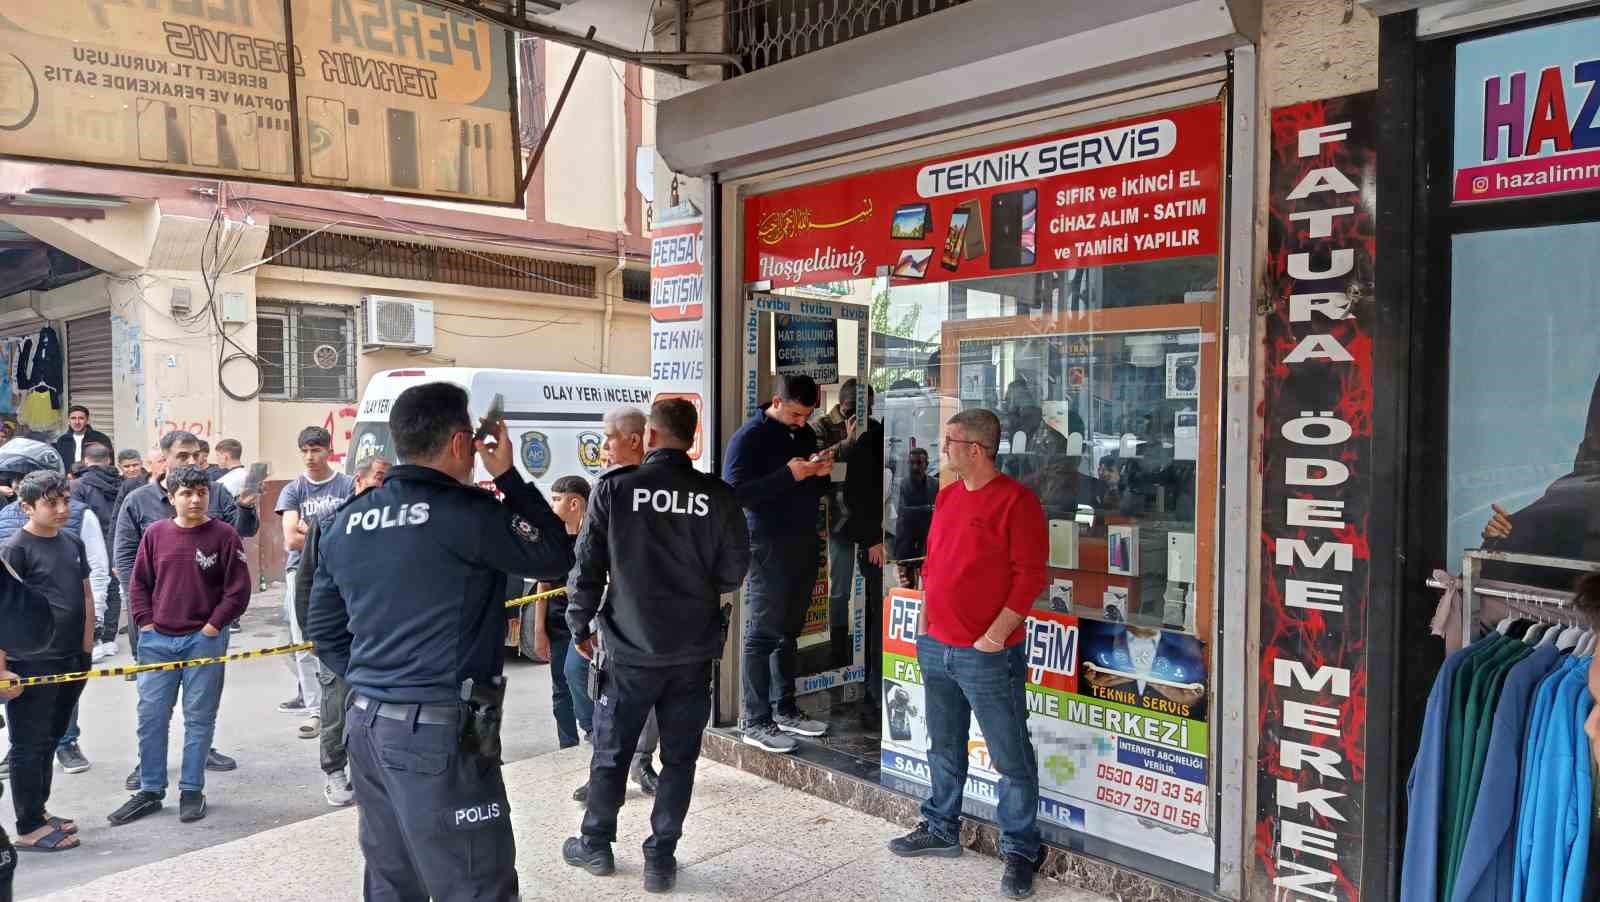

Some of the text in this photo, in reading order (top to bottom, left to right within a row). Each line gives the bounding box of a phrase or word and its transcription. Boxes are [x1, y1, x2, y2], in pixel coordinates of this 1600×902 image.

[1482, 60, 1600, 163] HAZ
[1056, 169, 1201, 207] SIFIR ve İKİNCİ EL
[1496, 163, 1600, 190] hazalimm
[1050, 213, 1096, 234] CİHAZ
[1100, 207, 1139, 228] ALIM
[1153, 198, 1207, 221] SATIM
[652, 235, 694, 265] PERSA
[1054, 228, 1200, 260] ve TAMİRİ YAPILIR
[1281, 121, 1360, 364] FATURA
[759, 245, 866, 283] Hoşgeldiniz
[756, 297, 791, 311] tivibu
[800, 301, 832, 316] tivibu
[543, 385, 573, 401] OLAY
[1275, 411, 1354, 613] ÖDEME
[1068, 699, 1189, 748] MERKEZİ
[1096, 763, 1202, 805] 0530 491 33 54
[1273, 658, 1351, 902] MERKEZ
[1096, 785, 1201, 828] 0537 373 01 56
